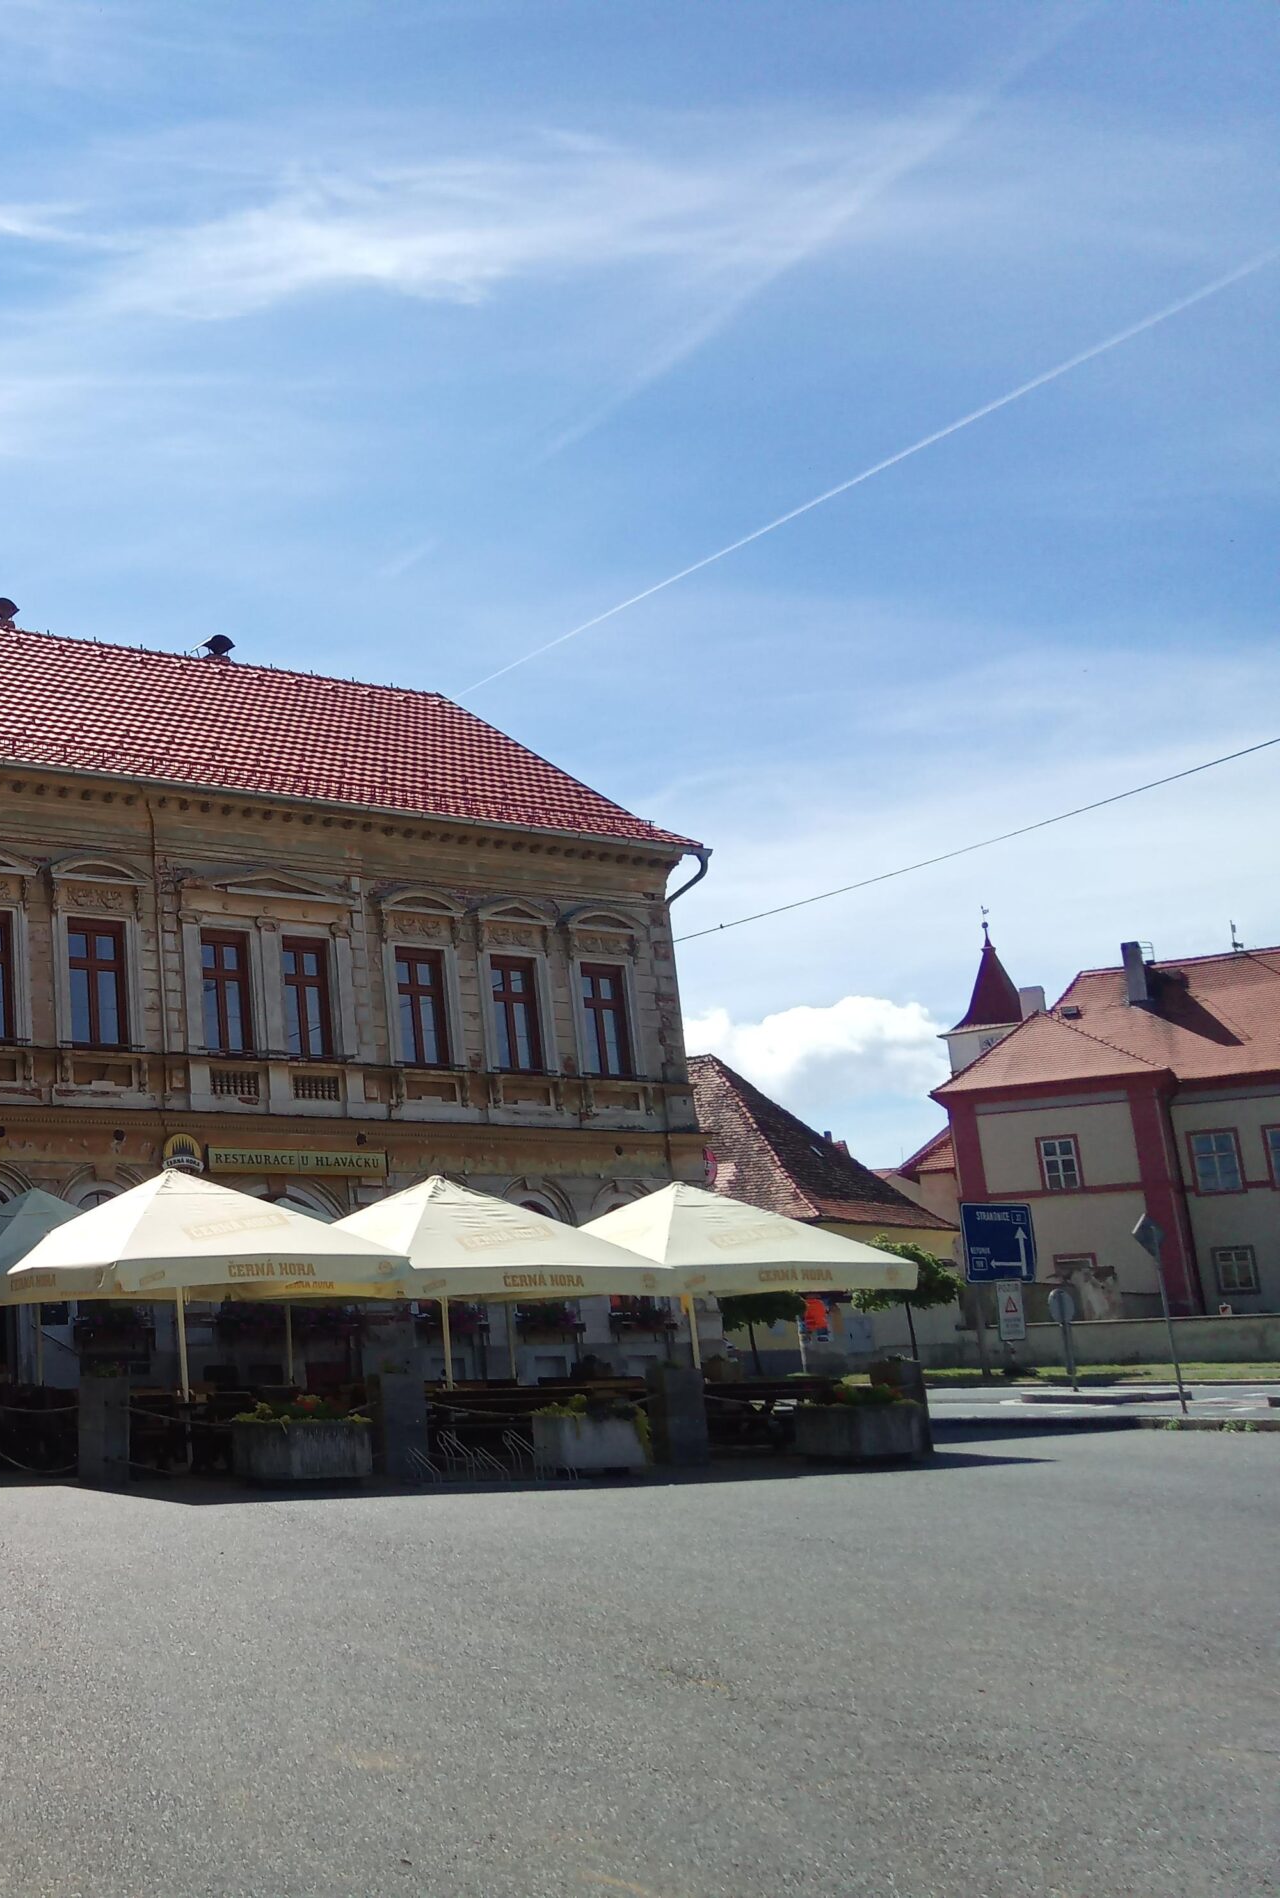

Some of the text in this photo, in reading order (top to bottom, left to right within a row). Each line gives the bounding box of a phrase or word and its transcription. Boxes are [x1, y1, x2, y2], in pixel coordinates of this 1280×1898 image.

[214, 1152, 296, 1167] RESTAURACE
[301, 1154, 310, 1167] U
[227, 1259, 317, 1278] ČERNÁ HORA
[757, 1266, 833, 1282] ČERNÁ HORA
[502, 1271, 584, 1288] ČERNÁ HORA
